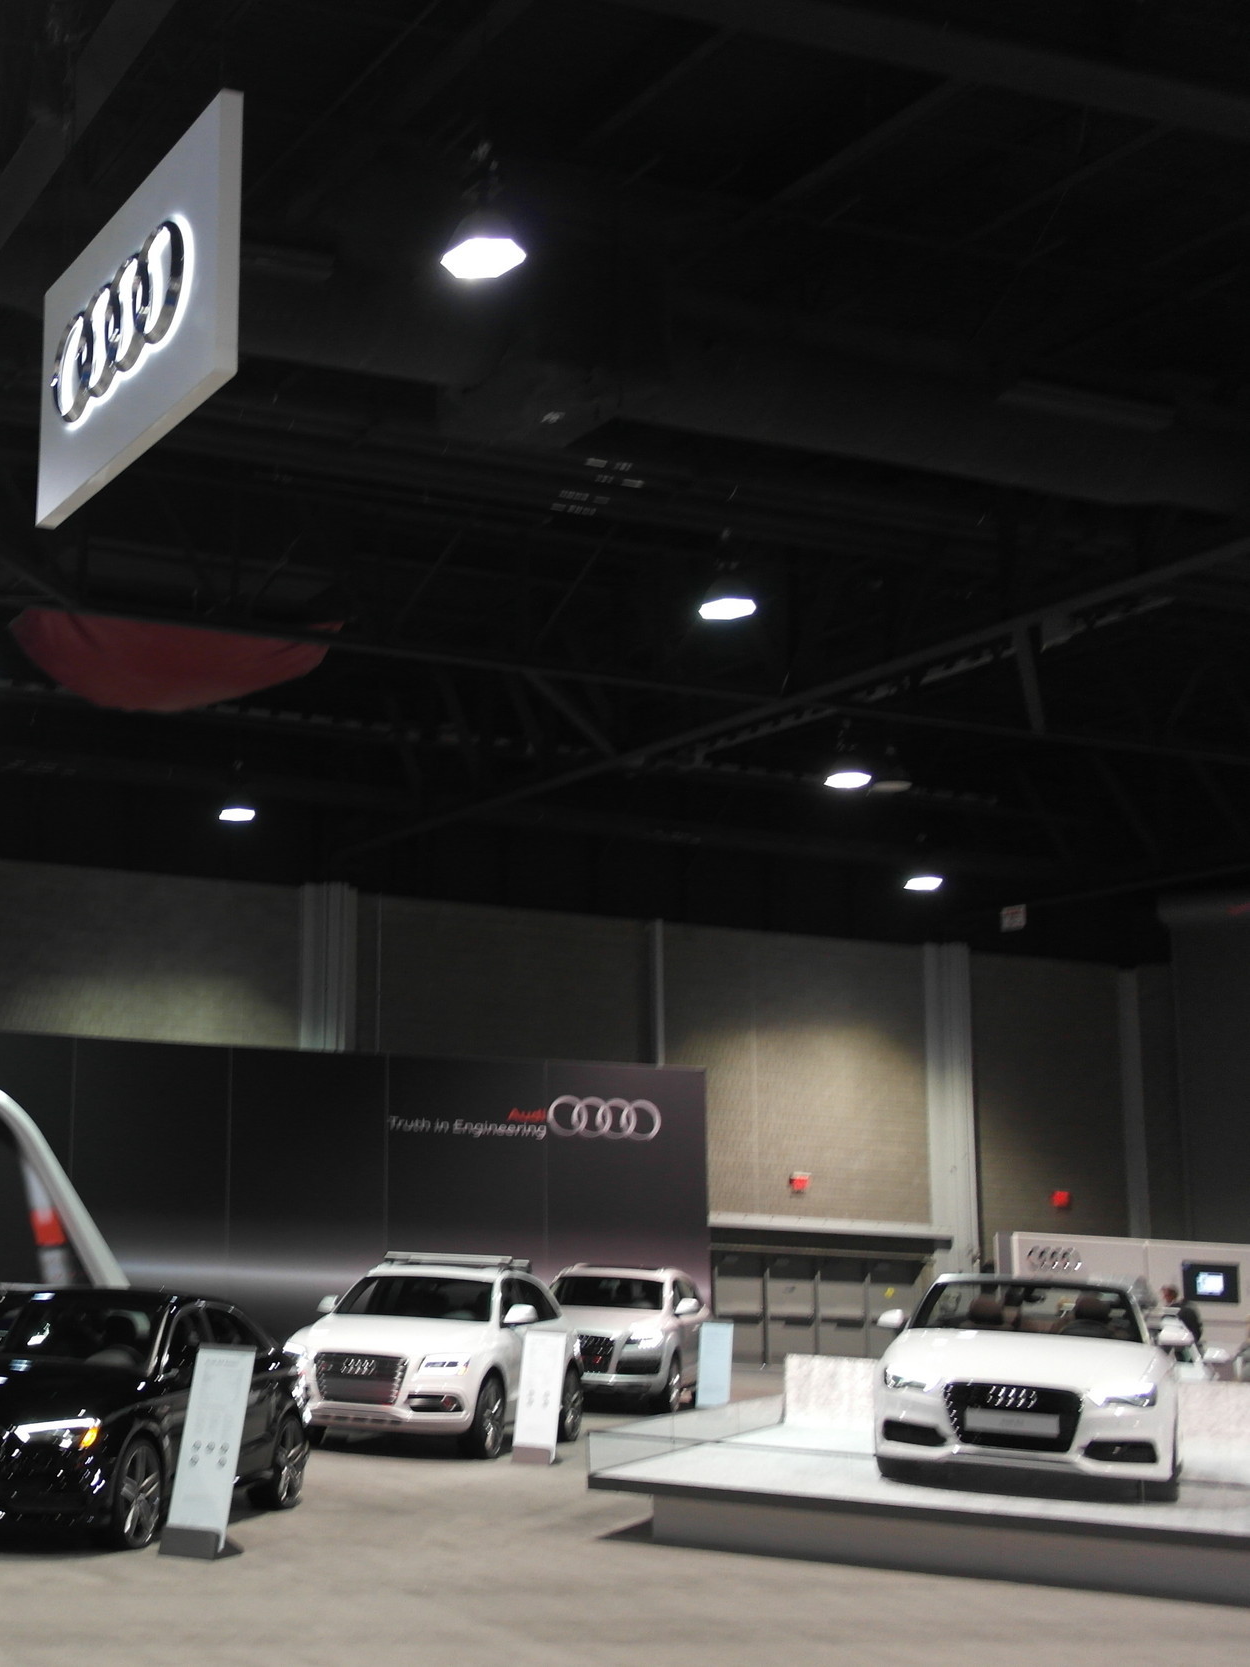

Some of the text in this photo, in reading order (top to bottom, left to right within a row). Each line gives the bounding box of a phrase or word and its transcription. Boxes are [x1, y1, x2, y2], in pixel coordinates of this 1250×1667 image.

[507, 1108, 546, 1122] Audi
[388, 1115, 548, 1140] Truth in Engineering
